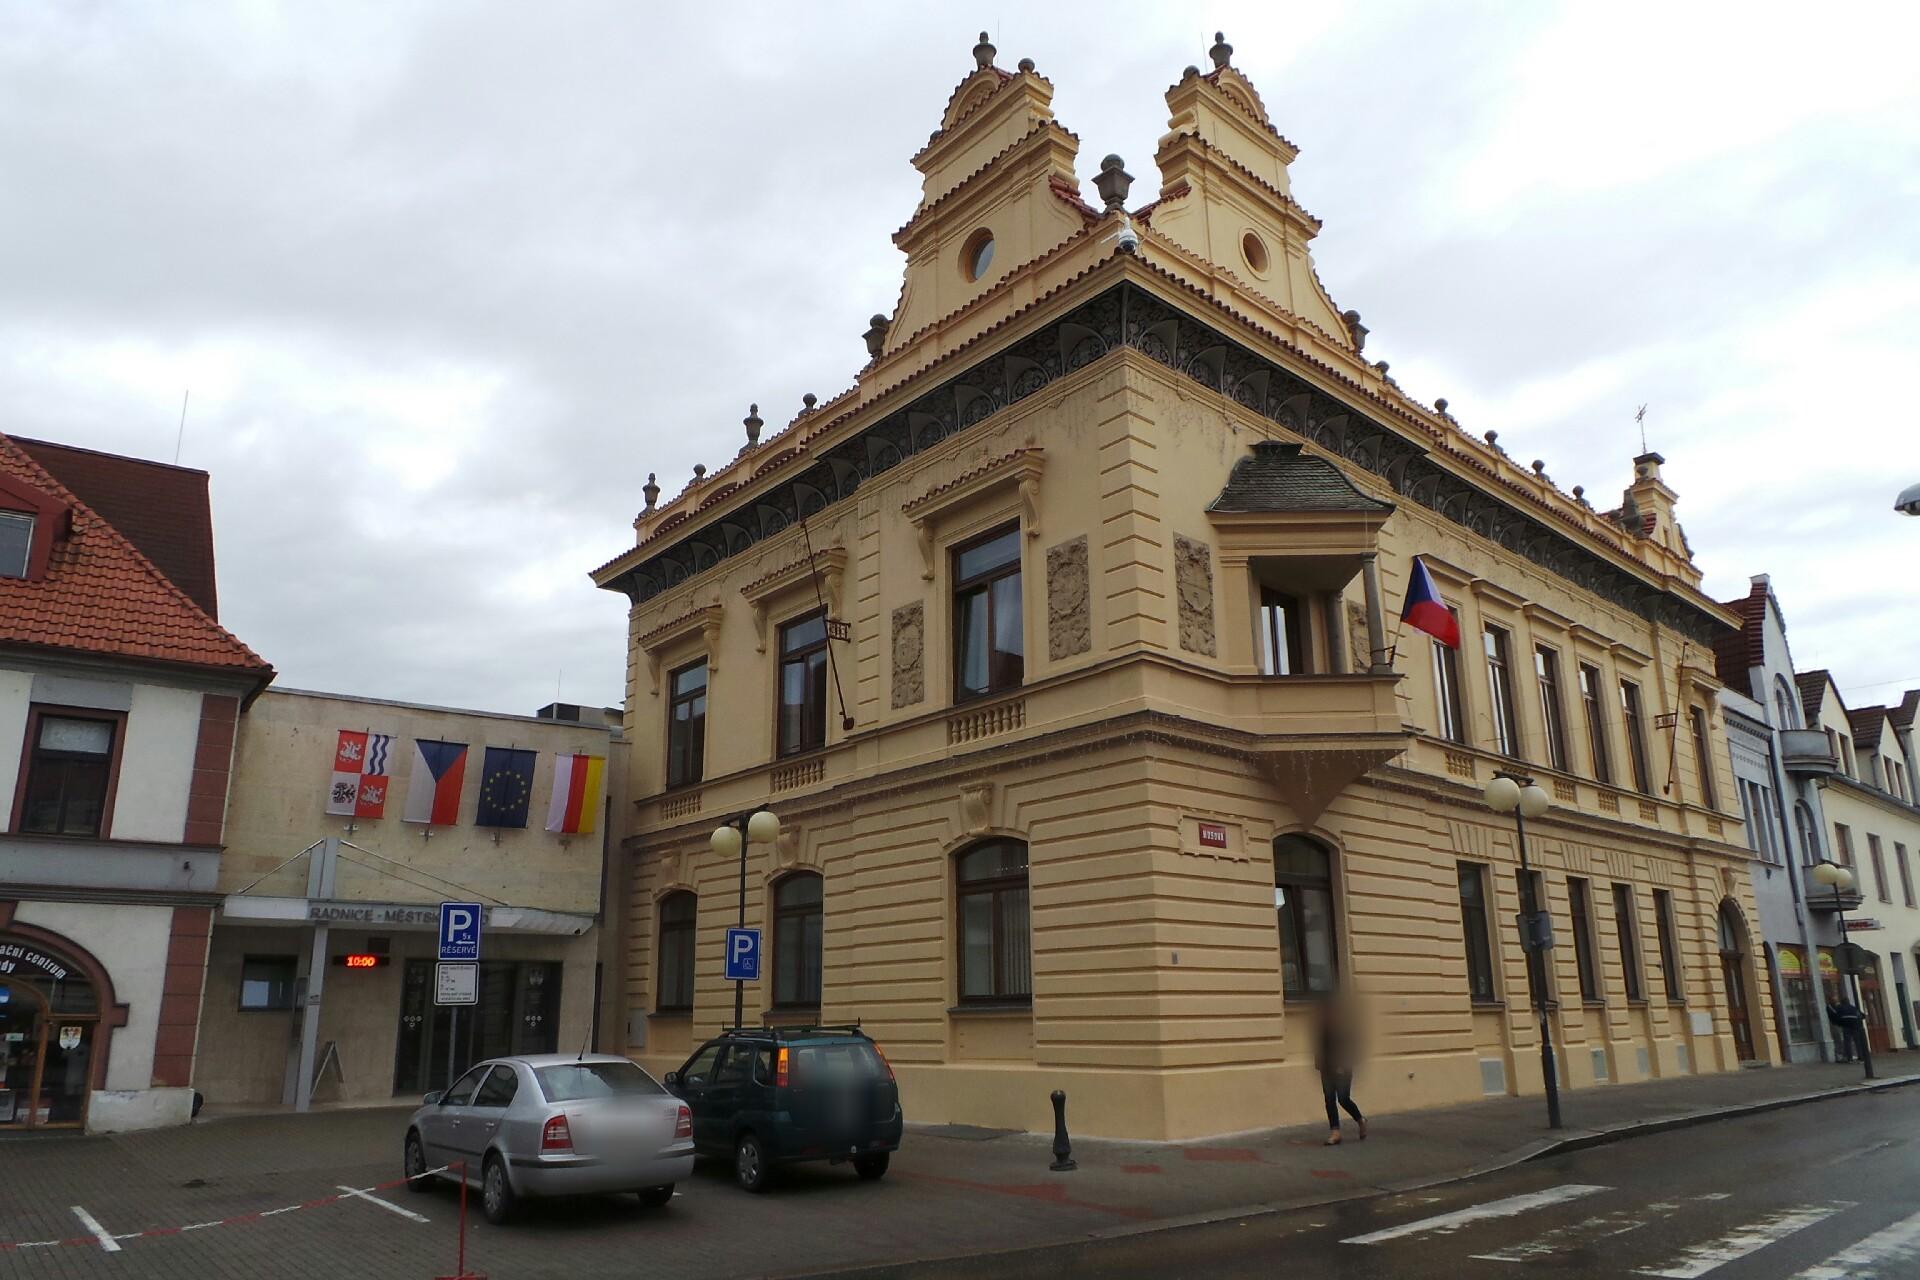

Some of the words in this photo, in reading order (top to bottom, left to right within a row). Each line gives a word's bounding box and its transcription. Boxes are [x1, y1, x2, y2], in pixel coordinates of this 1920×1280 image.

[310, 908, 374, 921] RADNICE
[447, 909, 473, 943] P
[441, 945, 476, 954] RÉSERVÉ
[733, 935, 754, 964] P
[25, 952, 68, 980] centrum
[346, 956, 376, 967] 10:00
